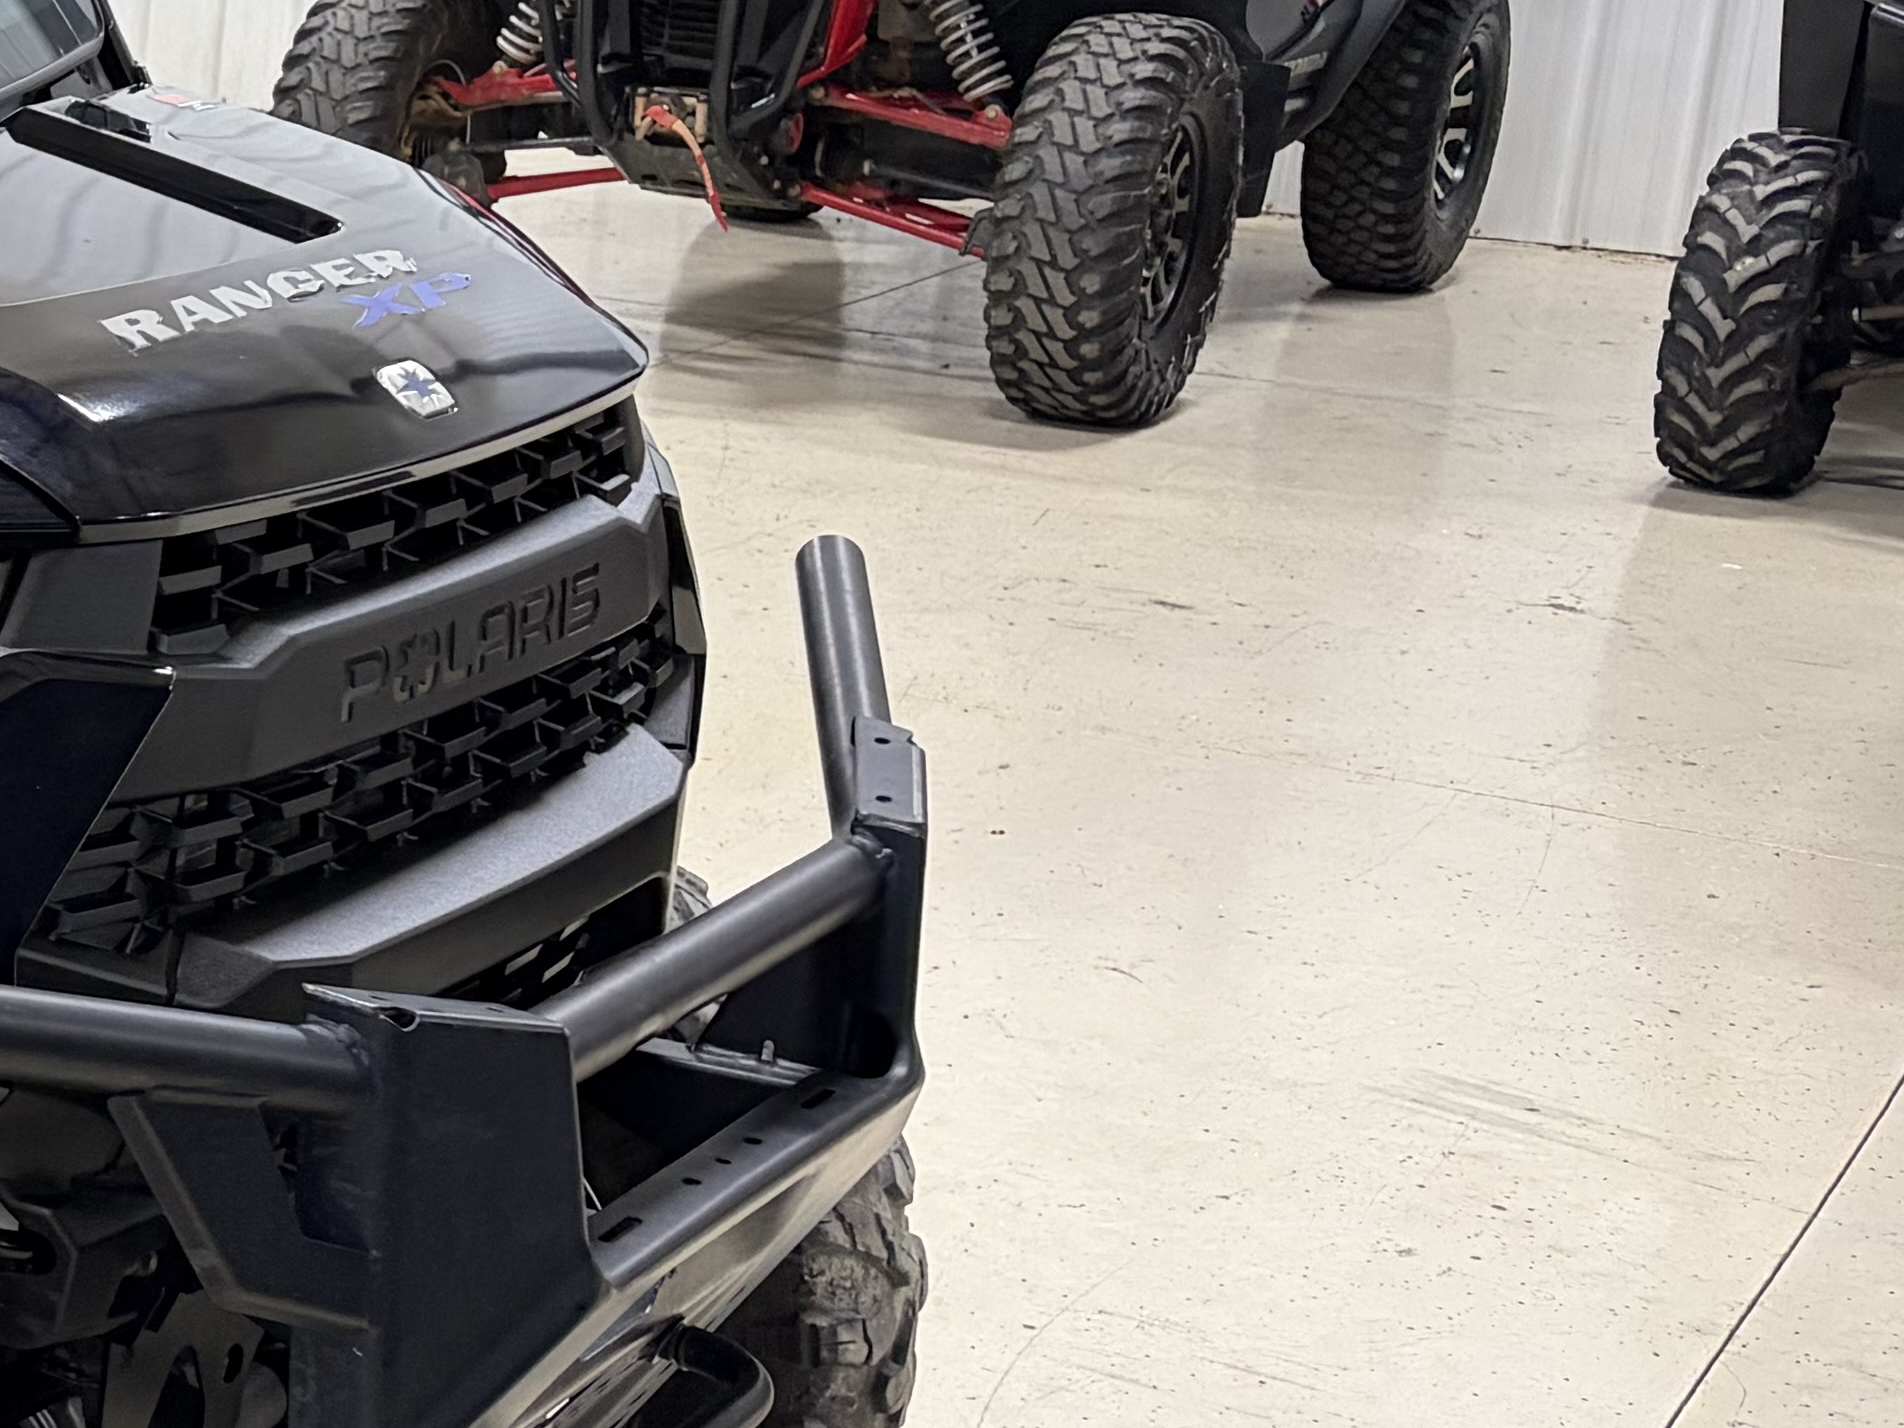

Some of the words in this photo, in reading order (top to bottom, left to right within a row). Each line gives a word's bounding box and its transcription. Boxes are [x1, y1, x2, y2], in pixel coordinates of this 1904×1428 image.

[98, 249, 418, 356] RANGER
[341, 272, 472, 329] XP
[342, 562, 600, 722] POLARIS
